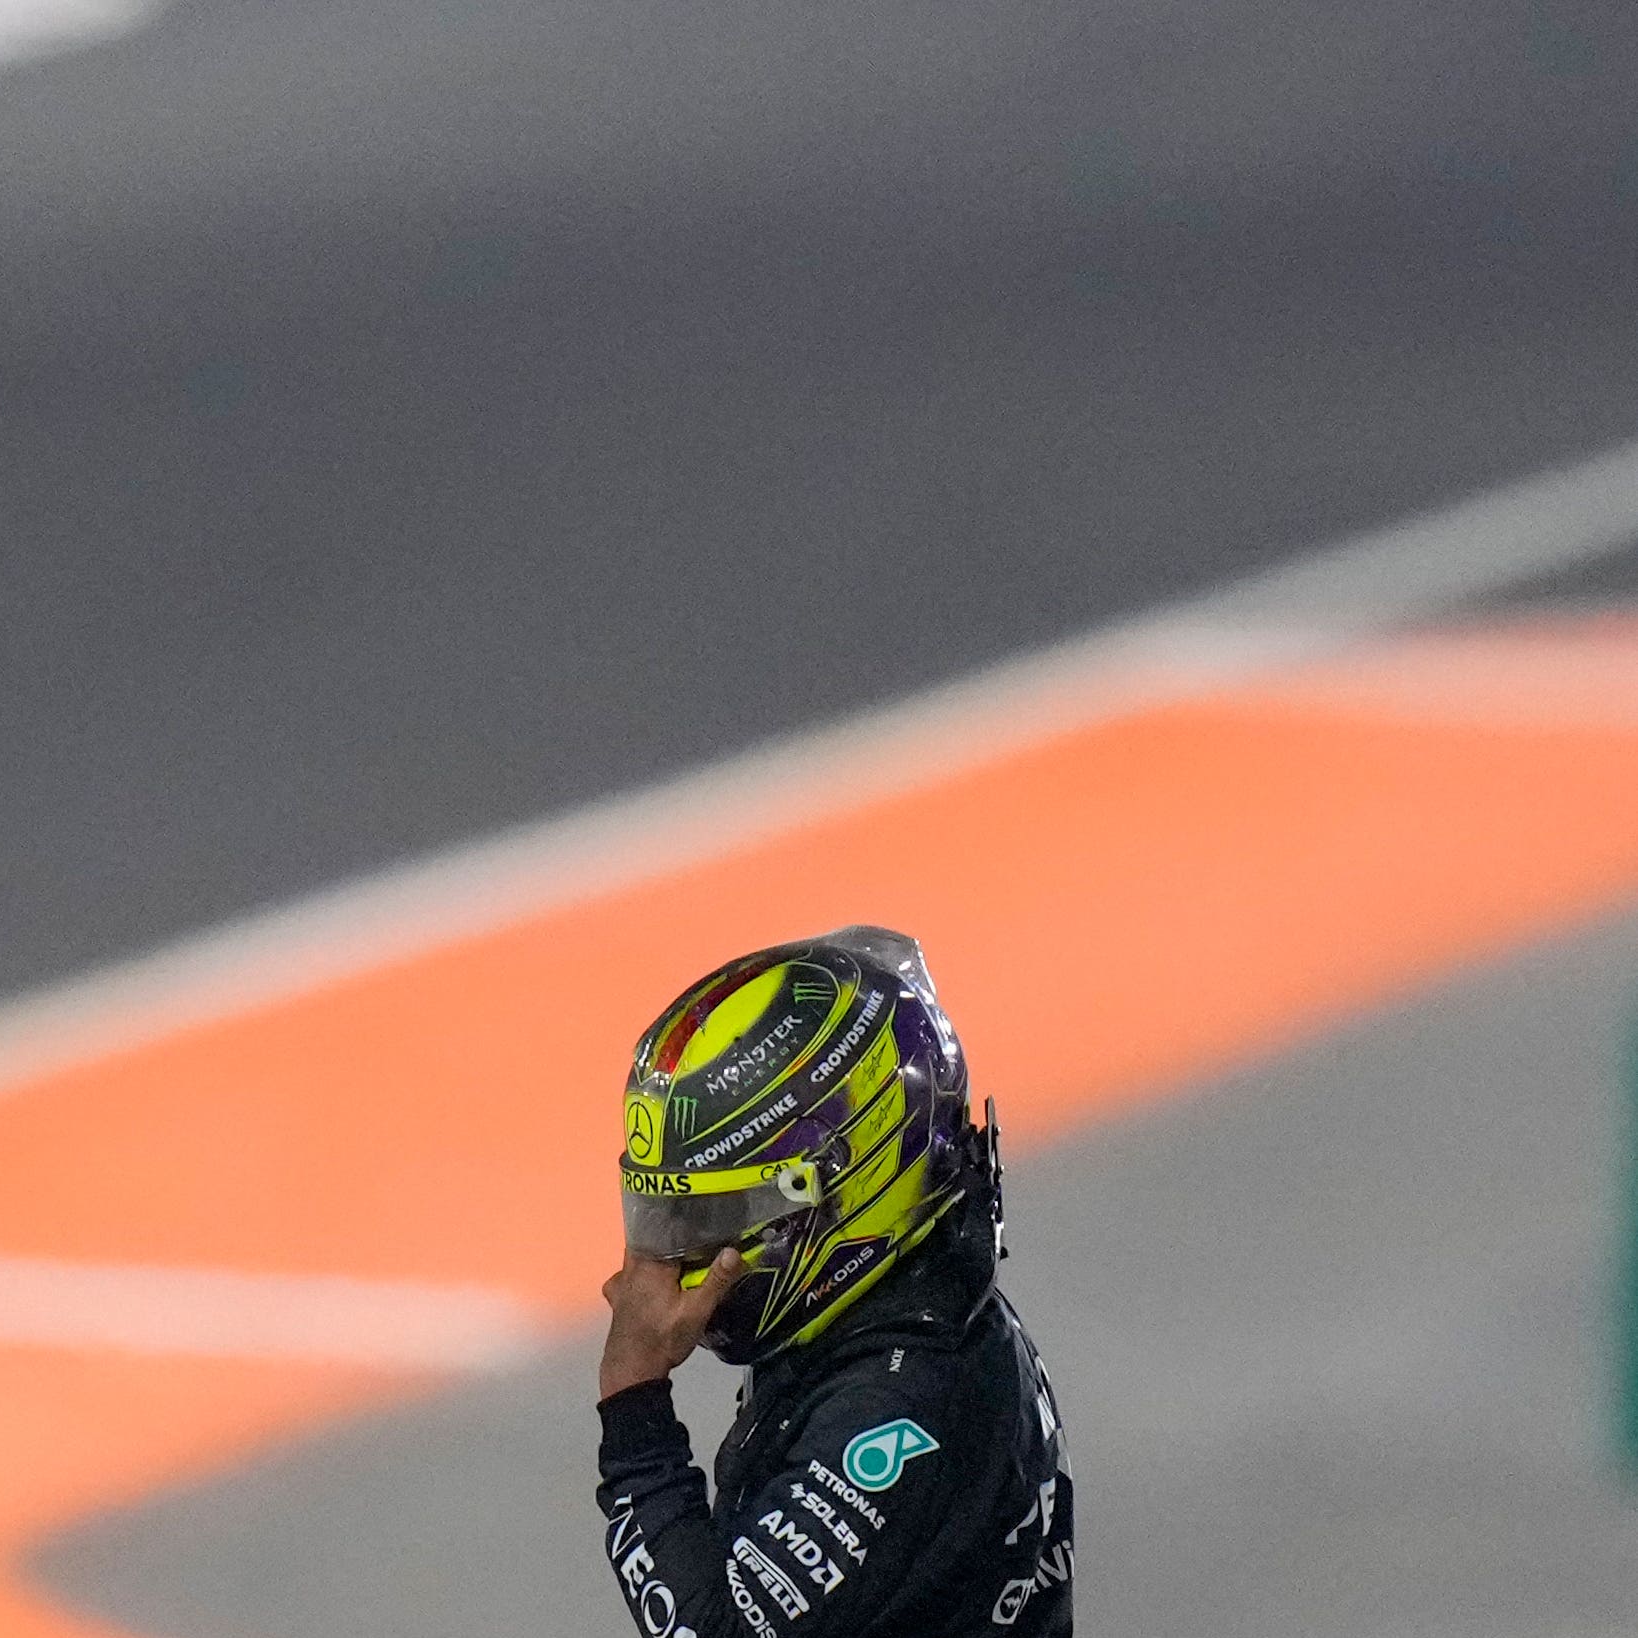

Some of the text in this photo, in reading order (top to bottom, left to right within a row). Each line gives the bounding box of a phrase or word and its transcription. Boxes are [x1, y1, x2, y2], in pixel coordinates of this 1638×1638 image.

[706, 1014, 803, 1096] MONSTER
[810, 989, 885, 1084] CROWDSTRIKE
[684, 1092, 799, 1170] CROWDSTRIKE
[623, 1171, 692, 1194] RONAS
[800, 1491, 868, 1567] SOLERA
[807, 1458, 886, 1531] PETRONAS
[757, 1509, 824, 1567] AMD
[732, 1535, 811, 1622] PIRELLI
